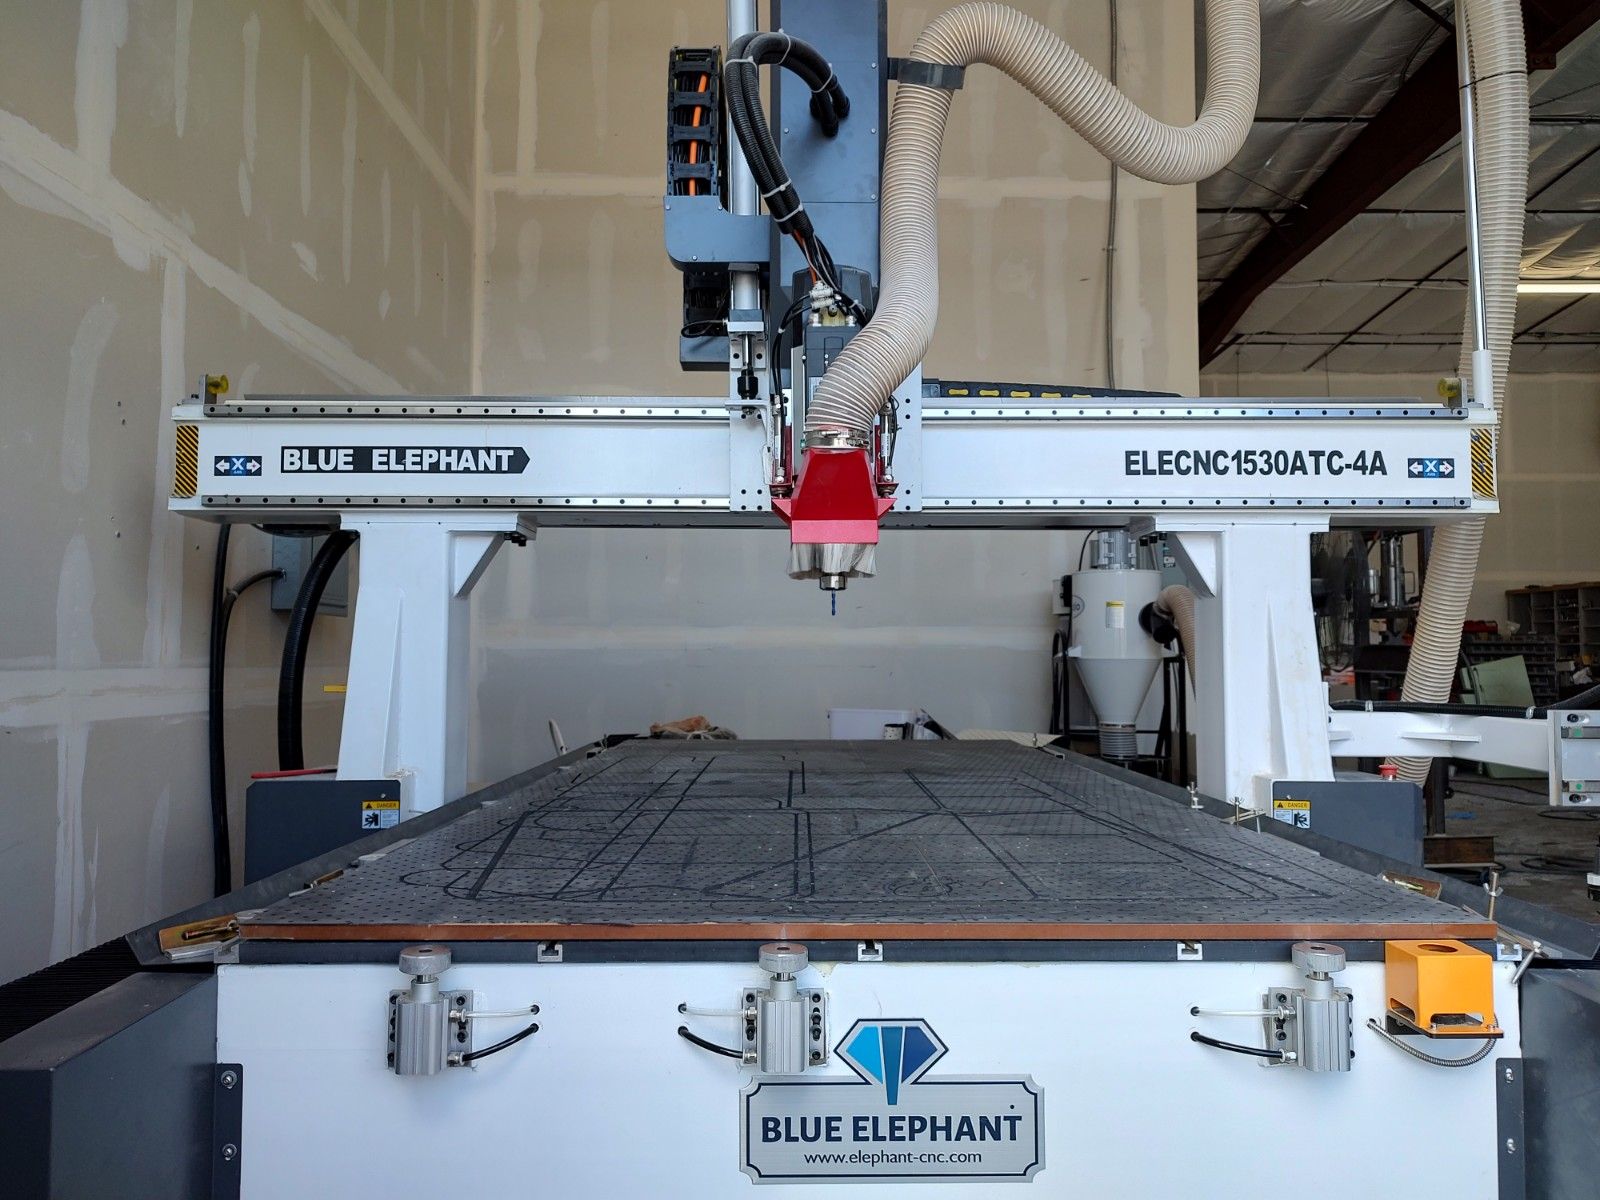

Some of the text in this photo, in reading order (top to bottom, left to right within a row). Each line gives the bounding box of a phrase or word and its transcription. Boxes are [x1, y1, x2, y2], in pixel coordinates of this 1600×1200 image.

[231, 458, 245, 470] X
[284, 449, 514, 471] BLUE ELEPHANT
[1125, 450, 1387, 476] ELECNC1530ATC-4A
[1425, 460, 1438, 472] X
[762, 1115, 1022, 1142] BLUE ELEPHANT
[804, 1150, 981, 1167] www.elephant-cnc.com
